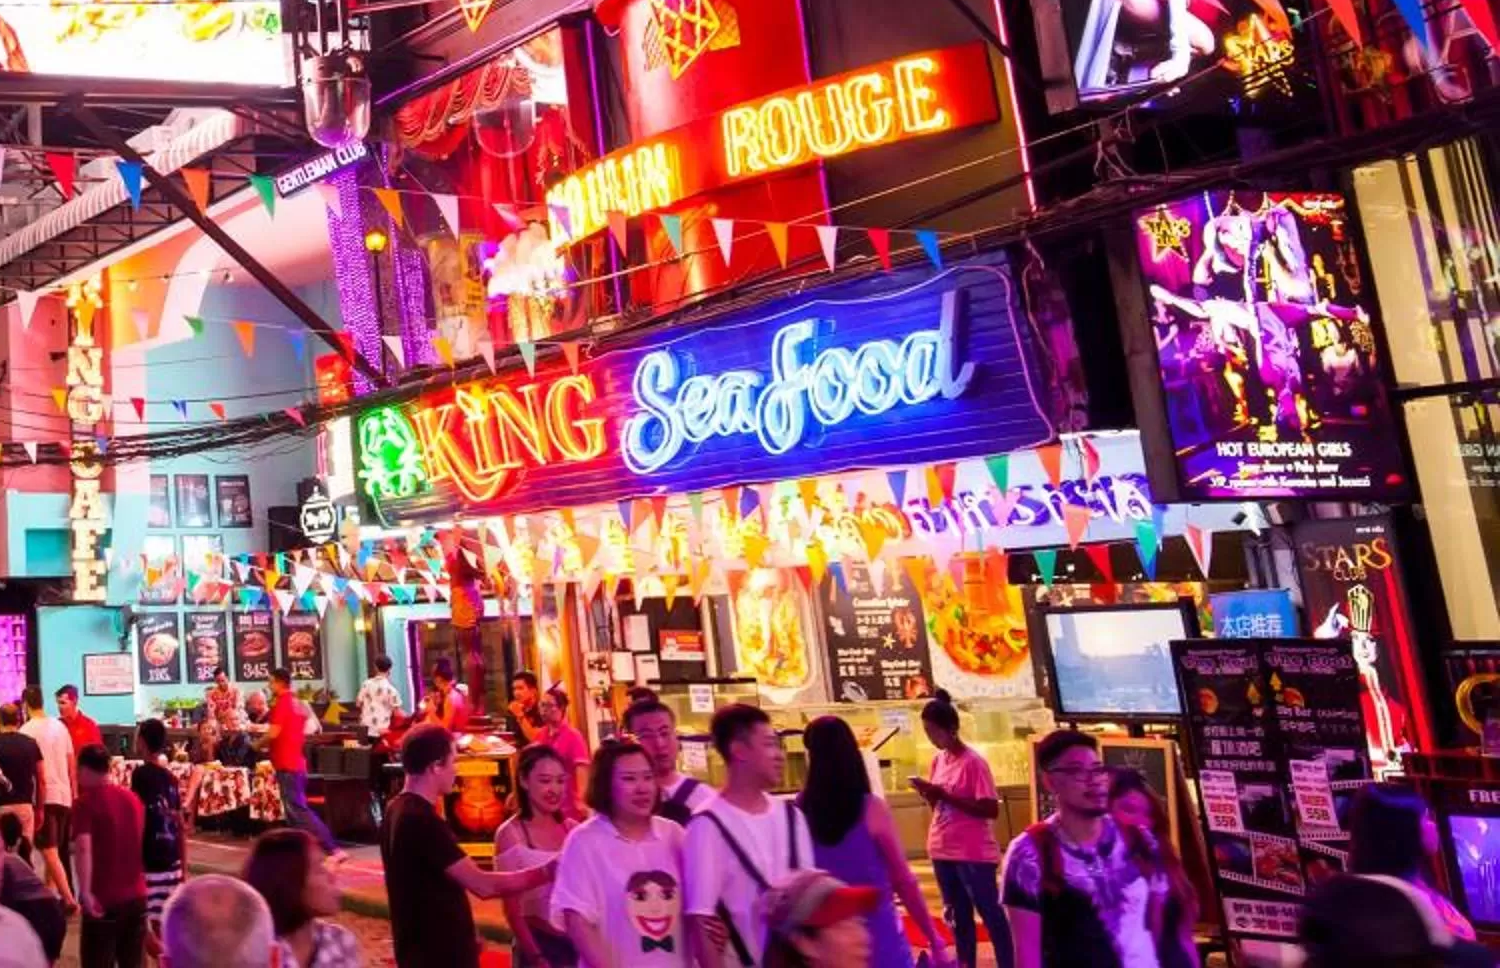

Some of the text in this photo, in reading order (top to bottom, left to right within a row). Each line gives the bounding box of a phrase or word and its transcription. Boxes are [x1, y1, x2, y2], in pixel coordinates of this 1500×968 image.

[722, 57, 947, 178] ROUGE
[334, 143, 367, 170] CLUB
[414, 289, 977, 502] KING Seafood
[1216, 442, 1353, 457] HOT EUROPEAN GIRLS
[1301, 537, 1393, 571] STARS
